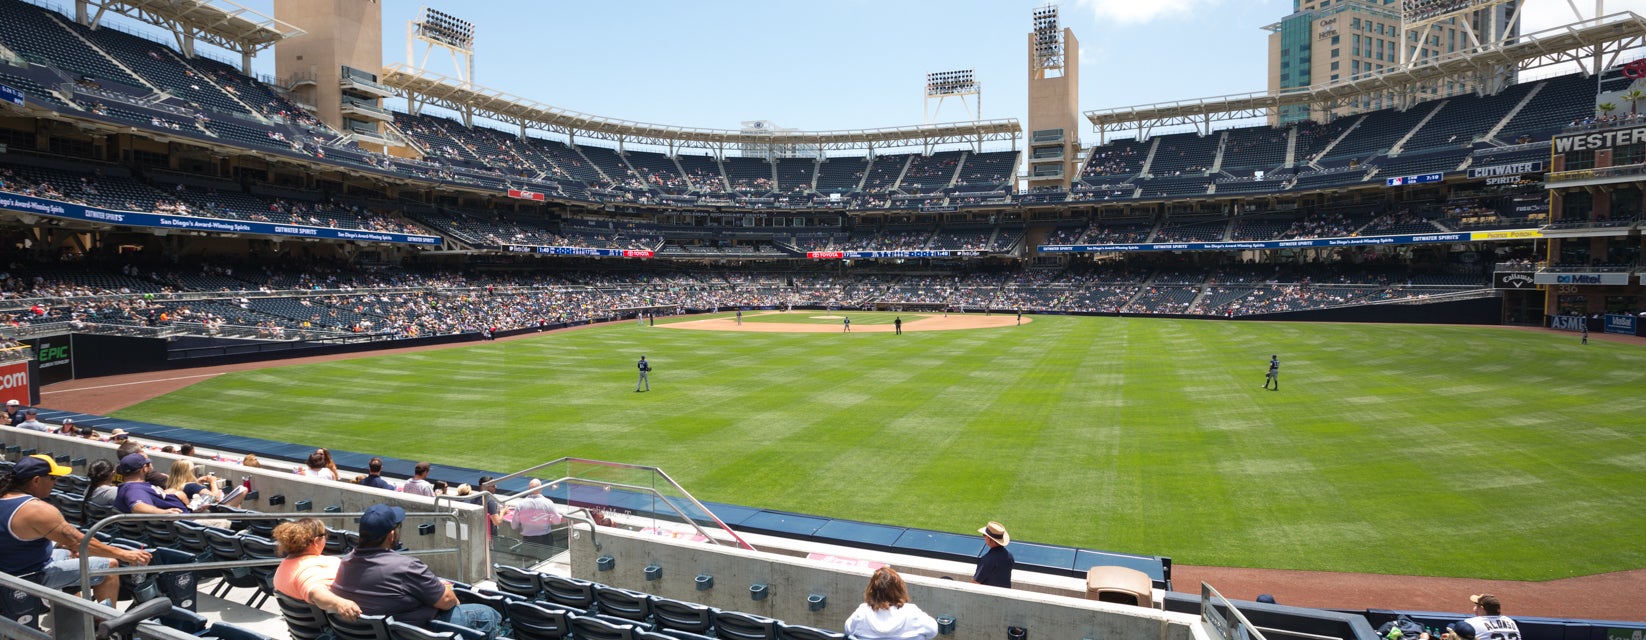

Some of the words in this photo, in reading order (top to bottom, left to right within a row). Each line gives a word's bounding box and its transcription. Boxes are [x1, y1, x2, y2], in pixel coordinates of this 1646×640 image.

[1475, 163, 1532, 177] CUTWATER
[1486, 176, 1520, 186] SPIRITS
[15, 200, 50, 214] Award-Winning
[50, 204, 64, 214] Spirits
[106, 212, 123, 221] SPIRITS
[194, 221, 234, 230] Award-Winning
[1502, 274, 1534, 284] Callaway
[1572, 274, 1601, 284] Mitel
[1559, 285, 1578, 294] 336
[1552, 316, 1586, 330] ASML
[40, 346, 68, 361] EPIC
[1484, 620, 1516, 630] ALONSO
